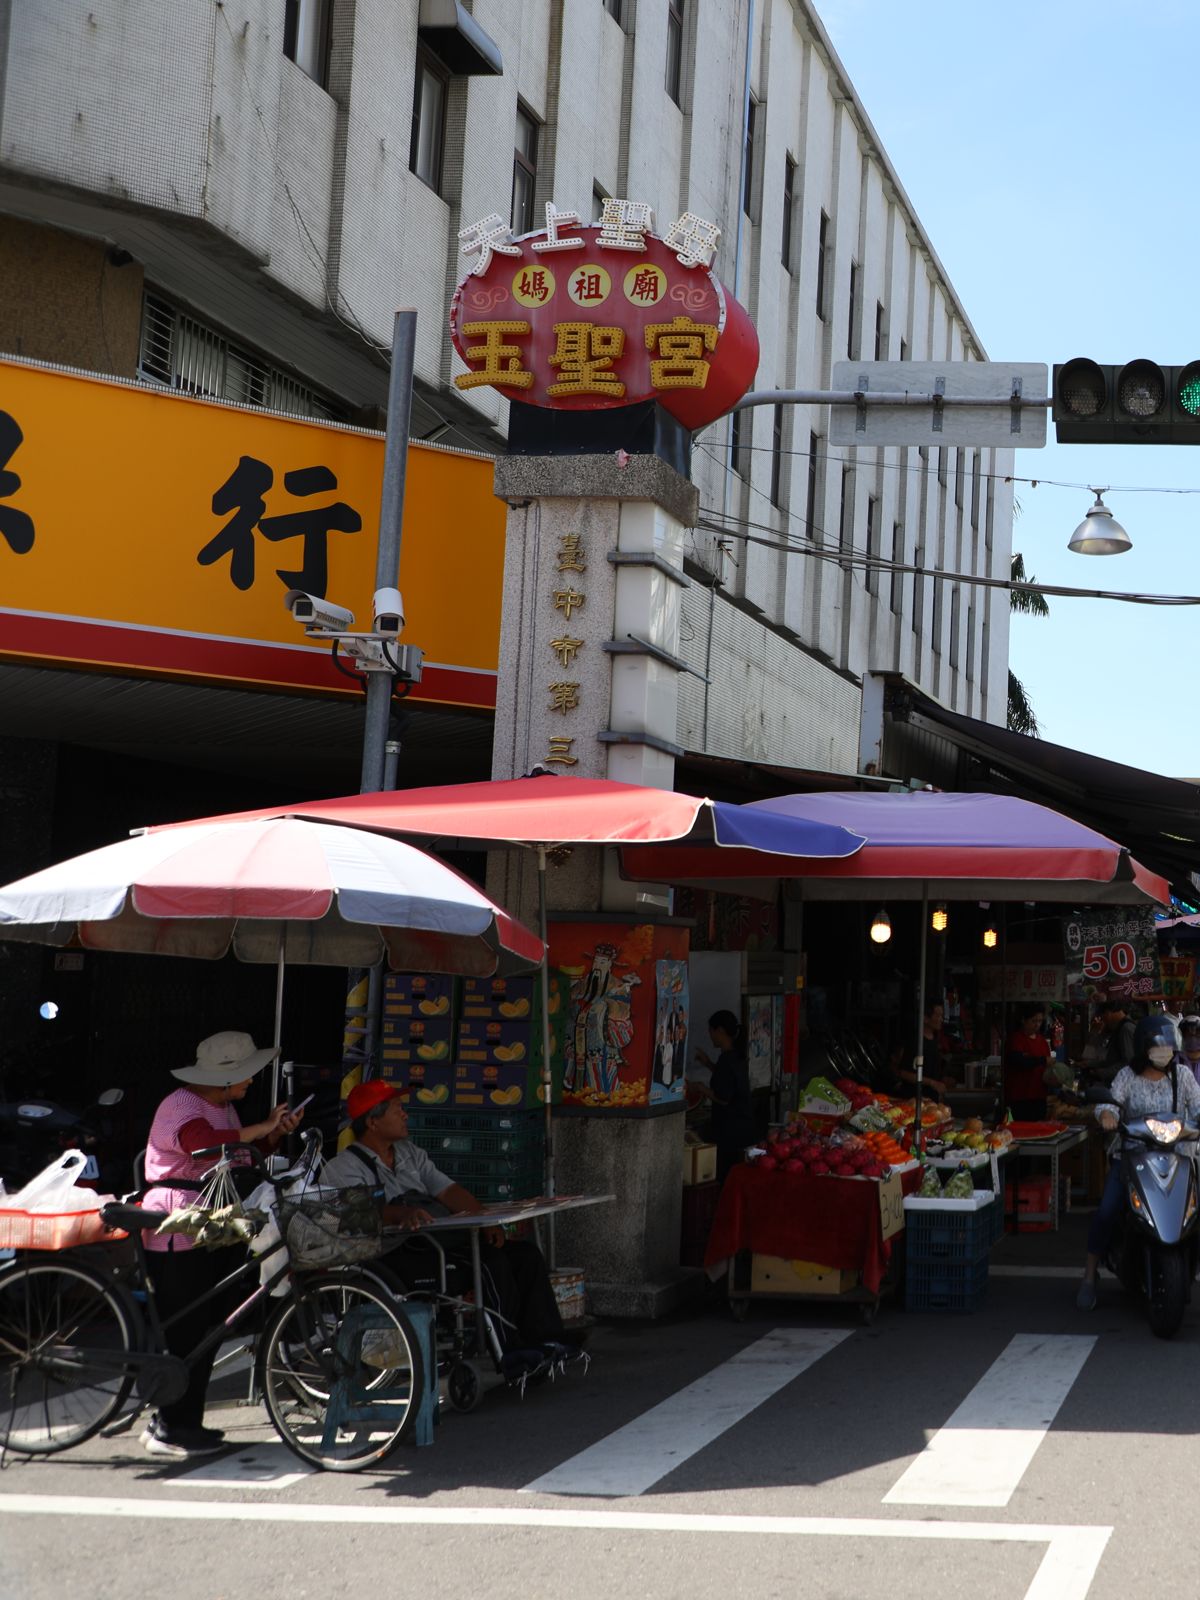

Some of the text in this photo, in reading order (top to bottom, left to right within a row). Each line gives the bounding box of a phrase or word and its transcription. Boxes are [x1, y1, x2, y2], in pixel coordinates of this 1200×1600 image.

[458, 198, 721, 277] 天上聖母
[518, 270, 659, 302] 媽祖廟
[454, 316, 720, 397] 玉聖宮
[1082, 941, 1136, 979] 50
[1138, 955, 1154, 972] 元
